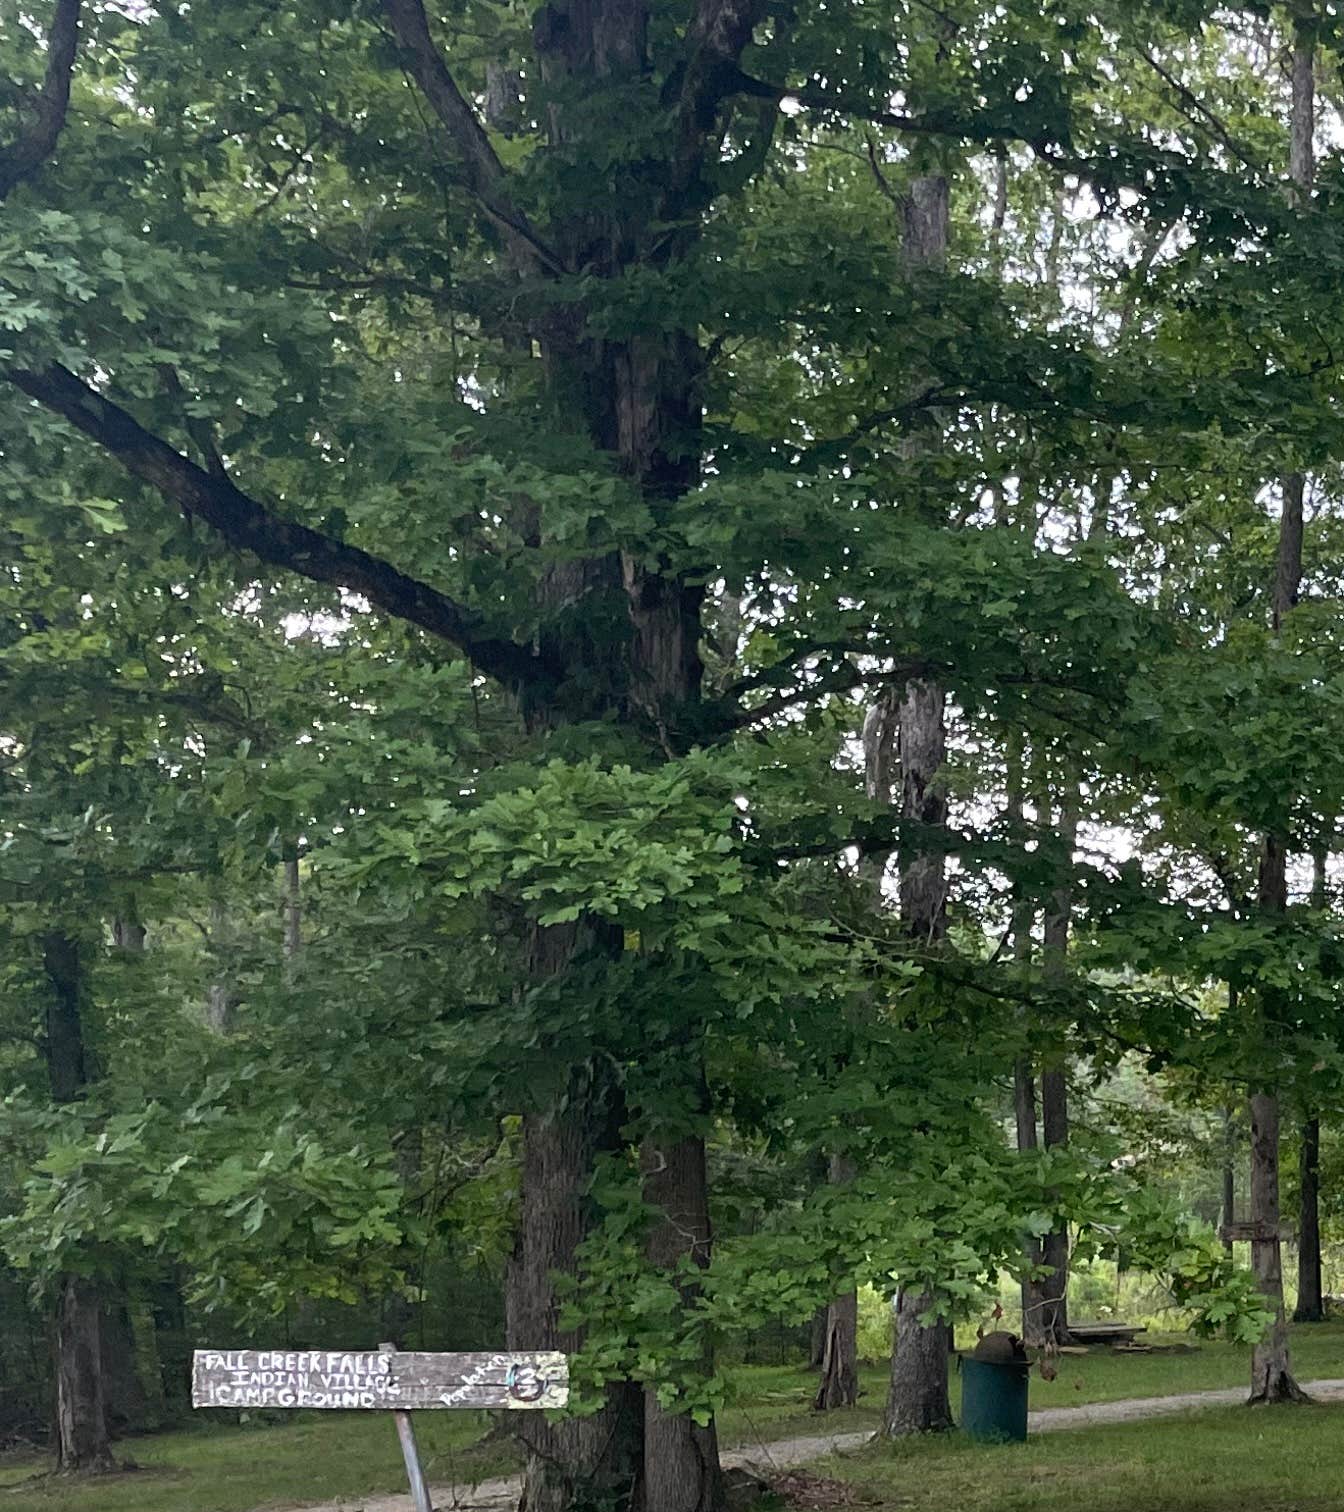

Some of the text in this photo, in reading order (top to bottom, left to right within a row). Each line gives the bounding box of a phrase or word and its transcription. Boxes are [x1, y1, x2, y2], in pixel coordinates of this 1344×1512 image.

[205, 1352, 390, 1375] FALL CREEK FALLS
[230, 1371, 309, 1388] INDIAN
